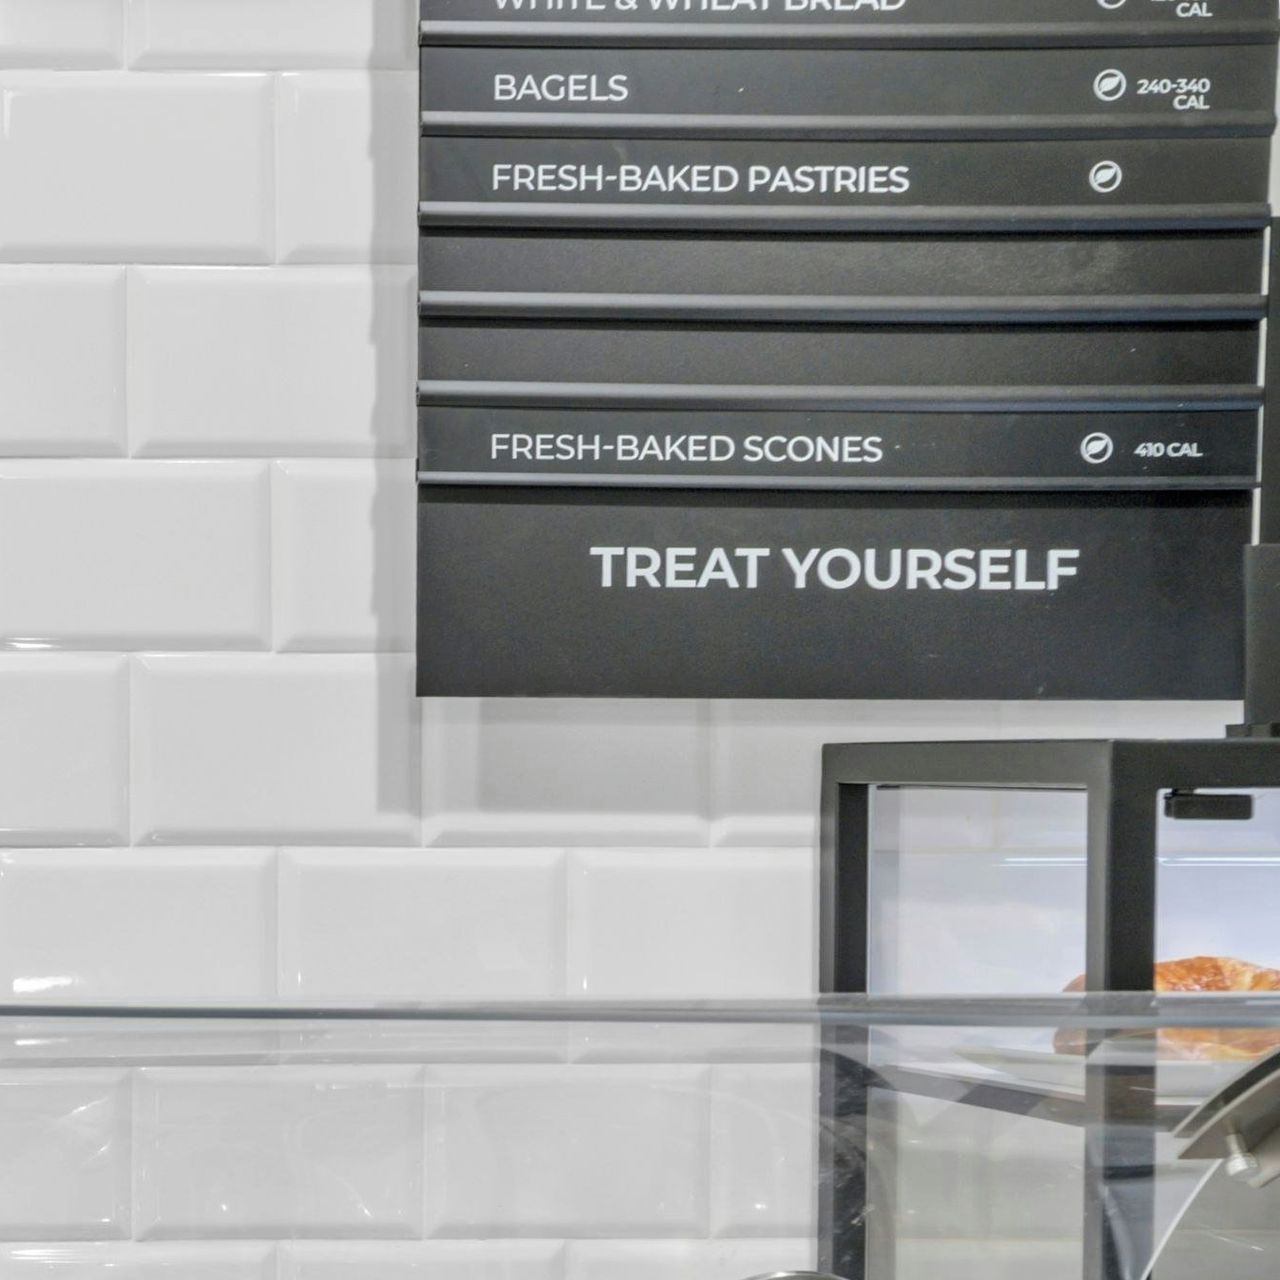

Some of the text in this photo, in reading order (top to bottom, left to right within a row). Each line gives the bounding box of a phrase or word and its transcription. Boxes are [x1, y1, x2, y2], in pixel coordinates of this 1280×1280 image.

[1176, 3, 1212, 17] CAL
[495, 75, 628, 101] BAGELS
[1138, 79, 1211, 95] 240-340
[1174, 95, 1209, 109] CAL
[494, 165, 909, 192] FRESH-BAKED PASTRIES
[492, 434, 882, 462] FRESH-BAKED SCONES
[1134, 442, 1204, 458] 410 CAL
[590, 547, 1079, 589] TREAT YOURSELF
